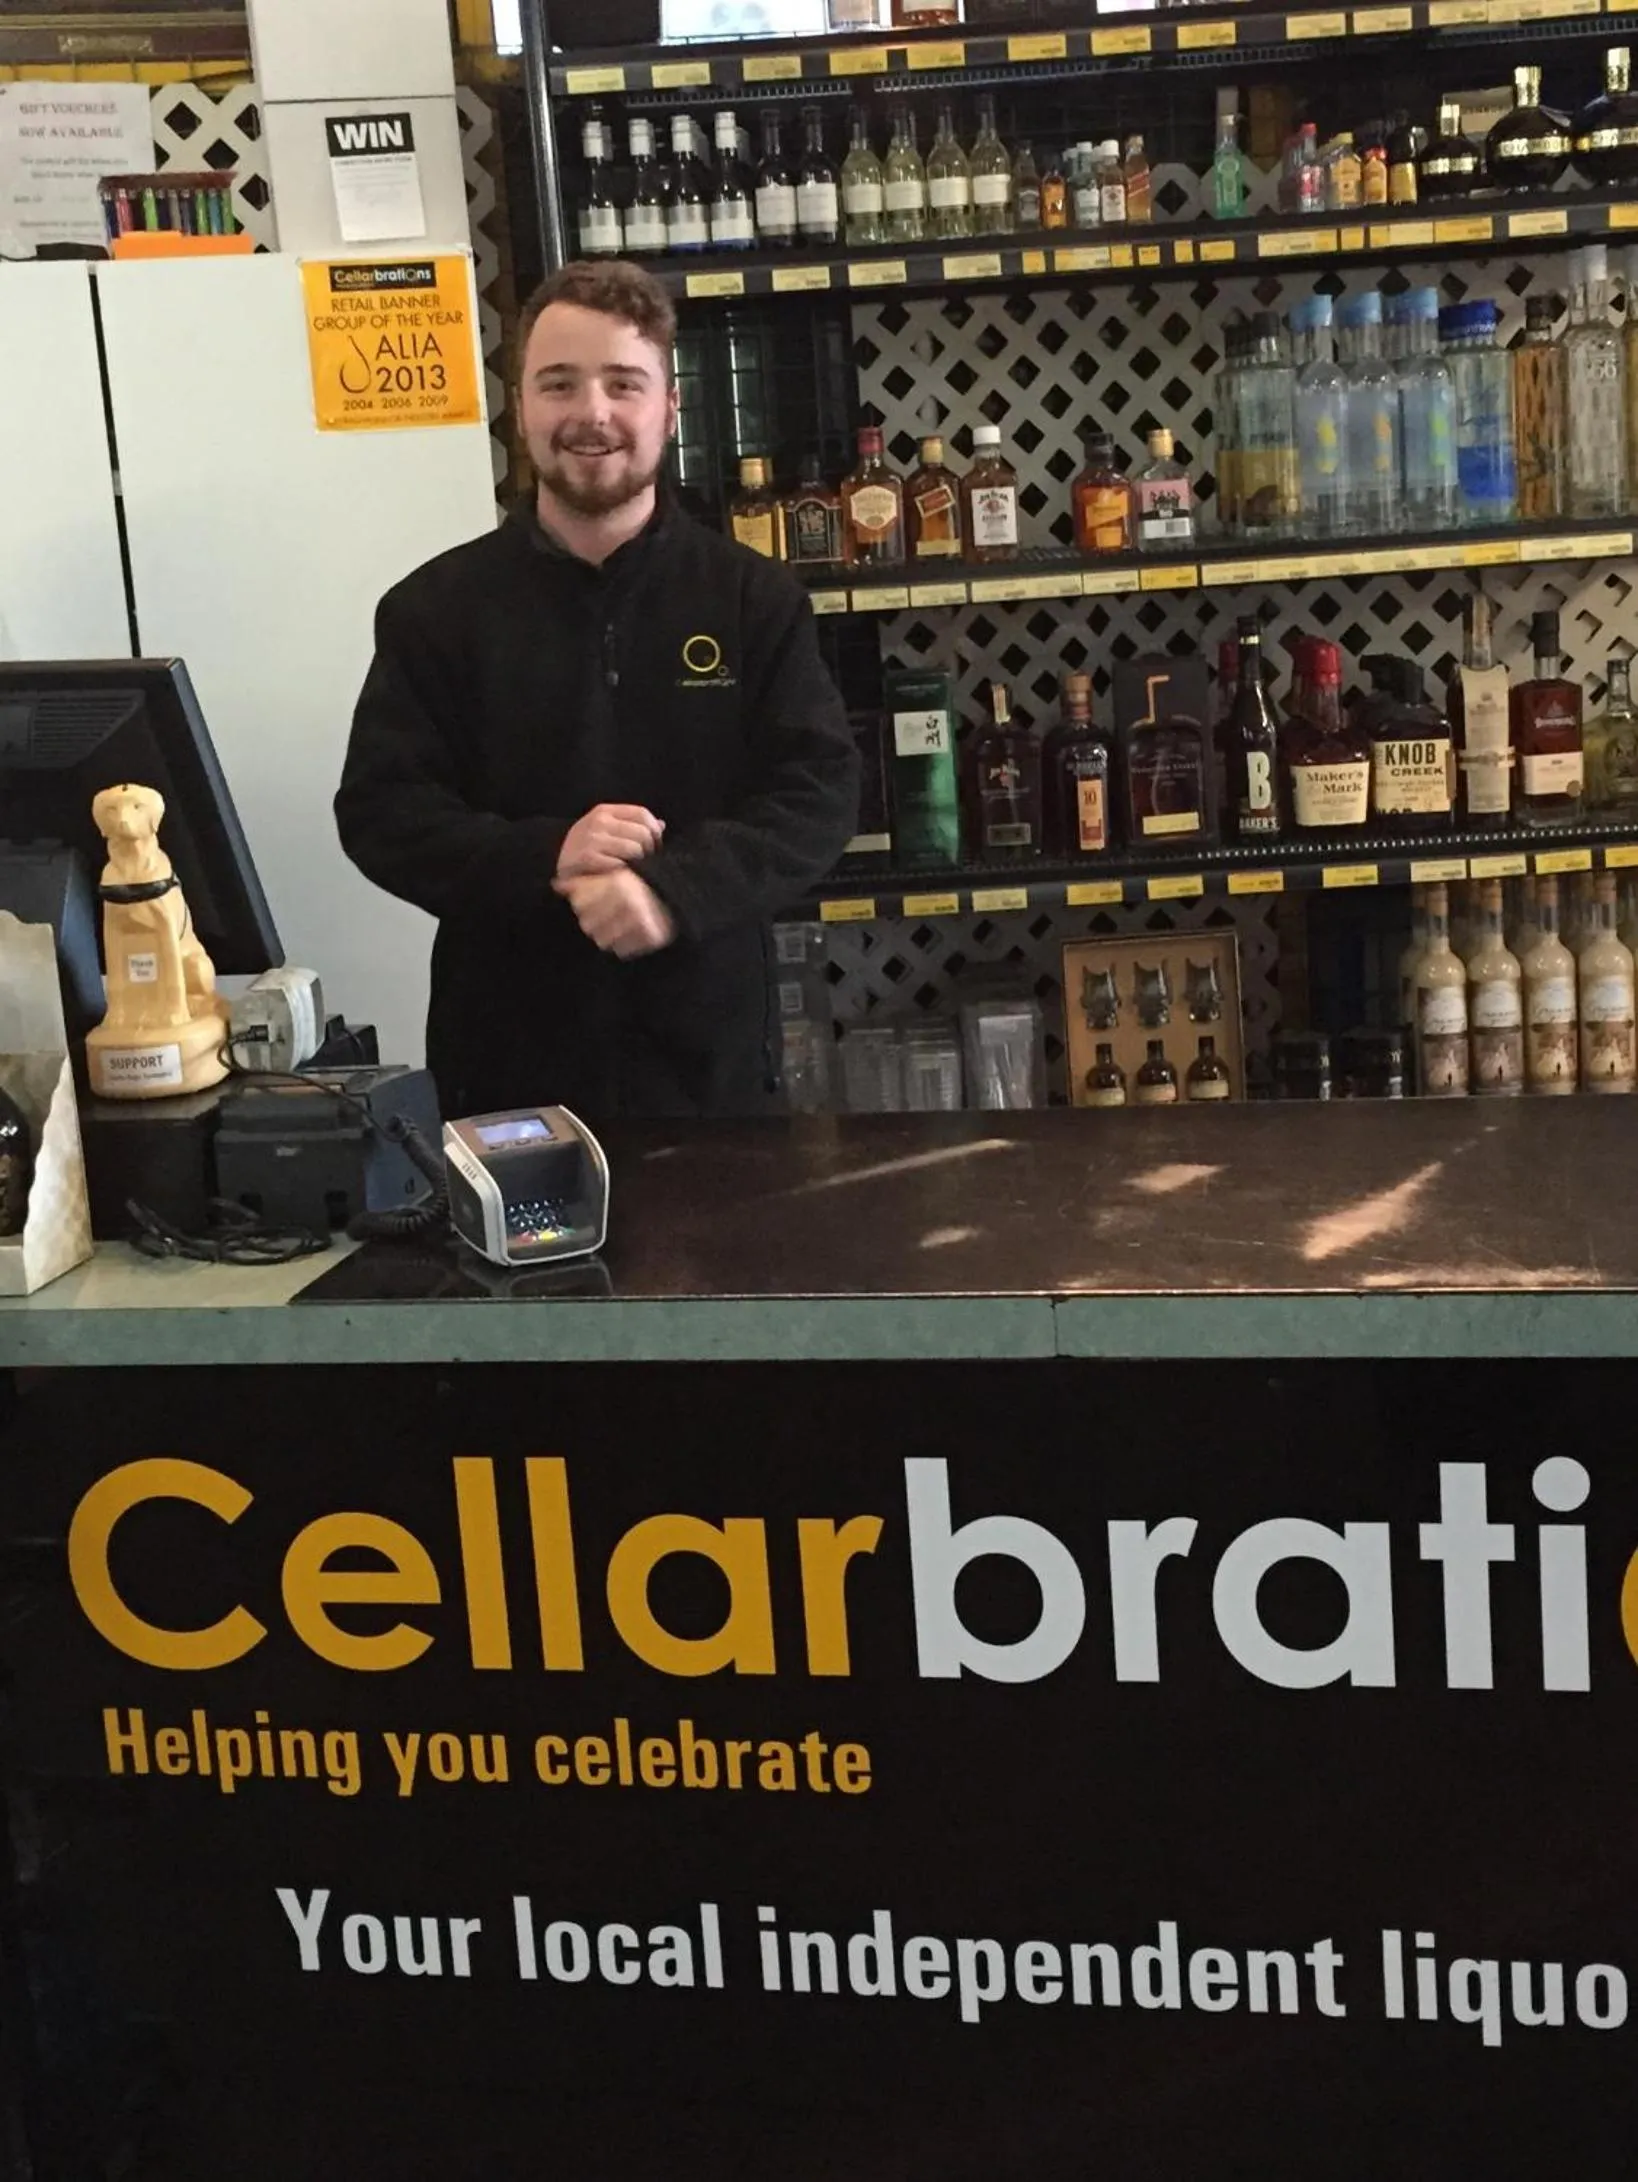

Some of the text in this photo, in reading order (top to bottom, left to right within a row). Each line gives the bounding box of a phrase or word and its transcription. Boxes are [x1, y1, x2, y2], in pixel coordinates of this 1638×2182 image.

[333, 120, 404, 150] WIN
[331, 294, 441, 312] RETAIL BANNER
[313, 310, 464, 331] GROUP OF THE YEAR
[375, 332, 443, 361] ALIA
[376, 364, 447, 393] 2013
[343, 399, 373, 411] 2004
[1385, 743, 1436, 766] KNOB
[1247, 752, 1272, 809] B
[1306, 771, 1364, 782] Maker's
[1391, 767, 1443, 777] CREEK
[1323, 783, 1363, 794] Mark
[109, 1054, 163, 1070] SUPPORT
[68, 1456, 1638, 1692] Cellarbrati
[104, 1708, 872, 1797] Helping you celebrate
[276, 1888, 482, 1976] Your
[513, 1896, 725, 1989] local
[758, 1905, 1347, 2023] independent
